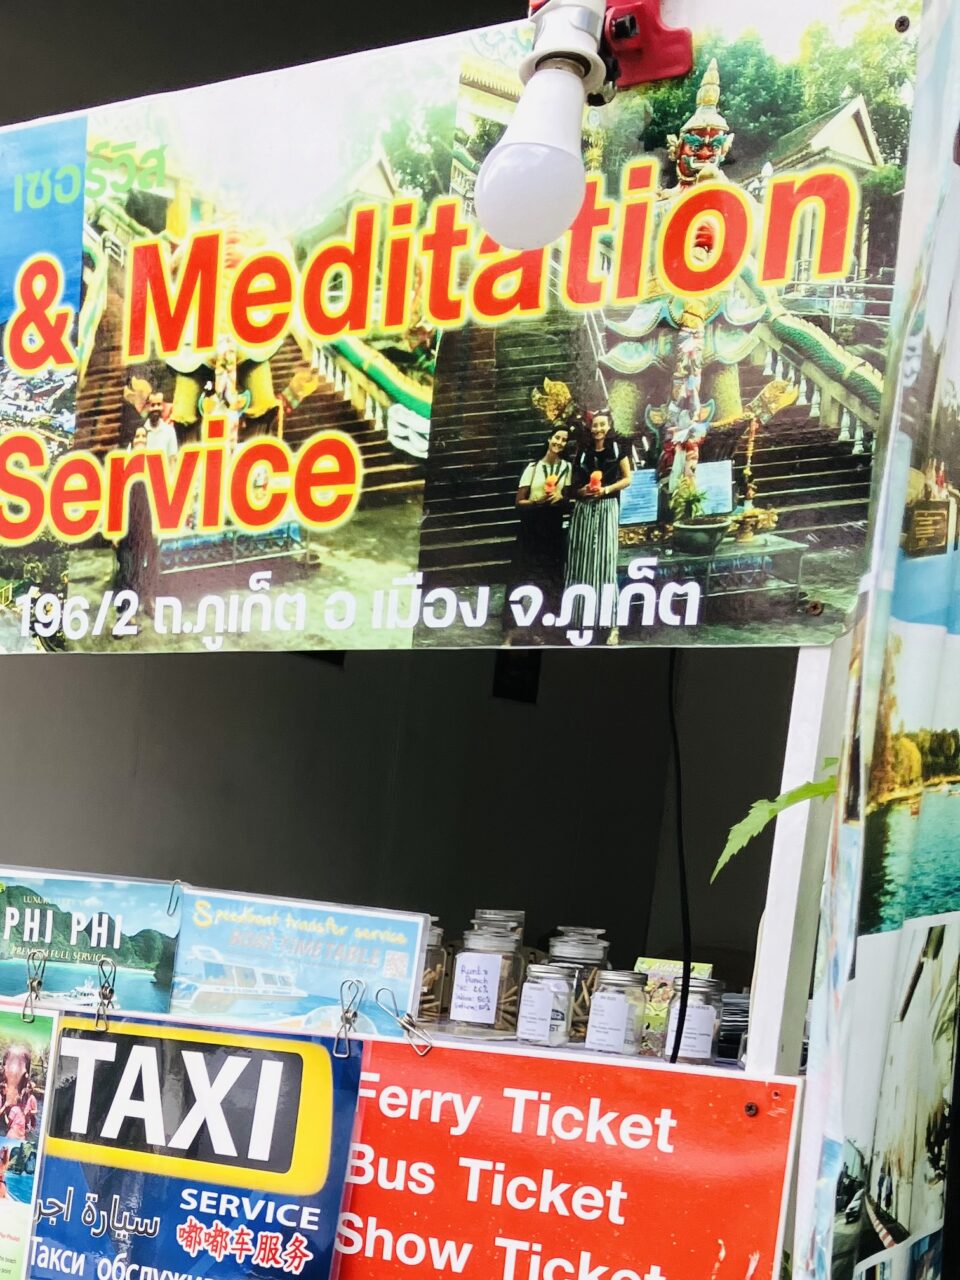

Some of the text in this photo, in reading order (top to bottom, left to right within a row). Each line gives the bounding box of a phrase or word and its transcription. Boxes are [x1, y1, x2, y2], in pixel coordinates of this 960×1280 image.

[6, 253, 77, 376] &
[124, 155, 863, 363] Meditation
[16, 584, 138, 640] 196/2
[371, 572, 488, 631] เมือง
[509, 558, 701, 647] จ.ภูเก็ต
[3, 906, 123, 949] PHI PHI
[60, 1036, 284, 1162] TAXI
[357, 1072, 677, 1153] Ferry Ticket
[33, 1186, 74, 1229] اجر
[180, 1188, 320, 1230] SERVICE
[344, 1142, 627, 1225] Bus Ticket
[31, 1236, 85, 1276] Такси
[177, 1215, 314, 1275] 嘟嘟车服务
[333, 1212, 473, 1274] Show
